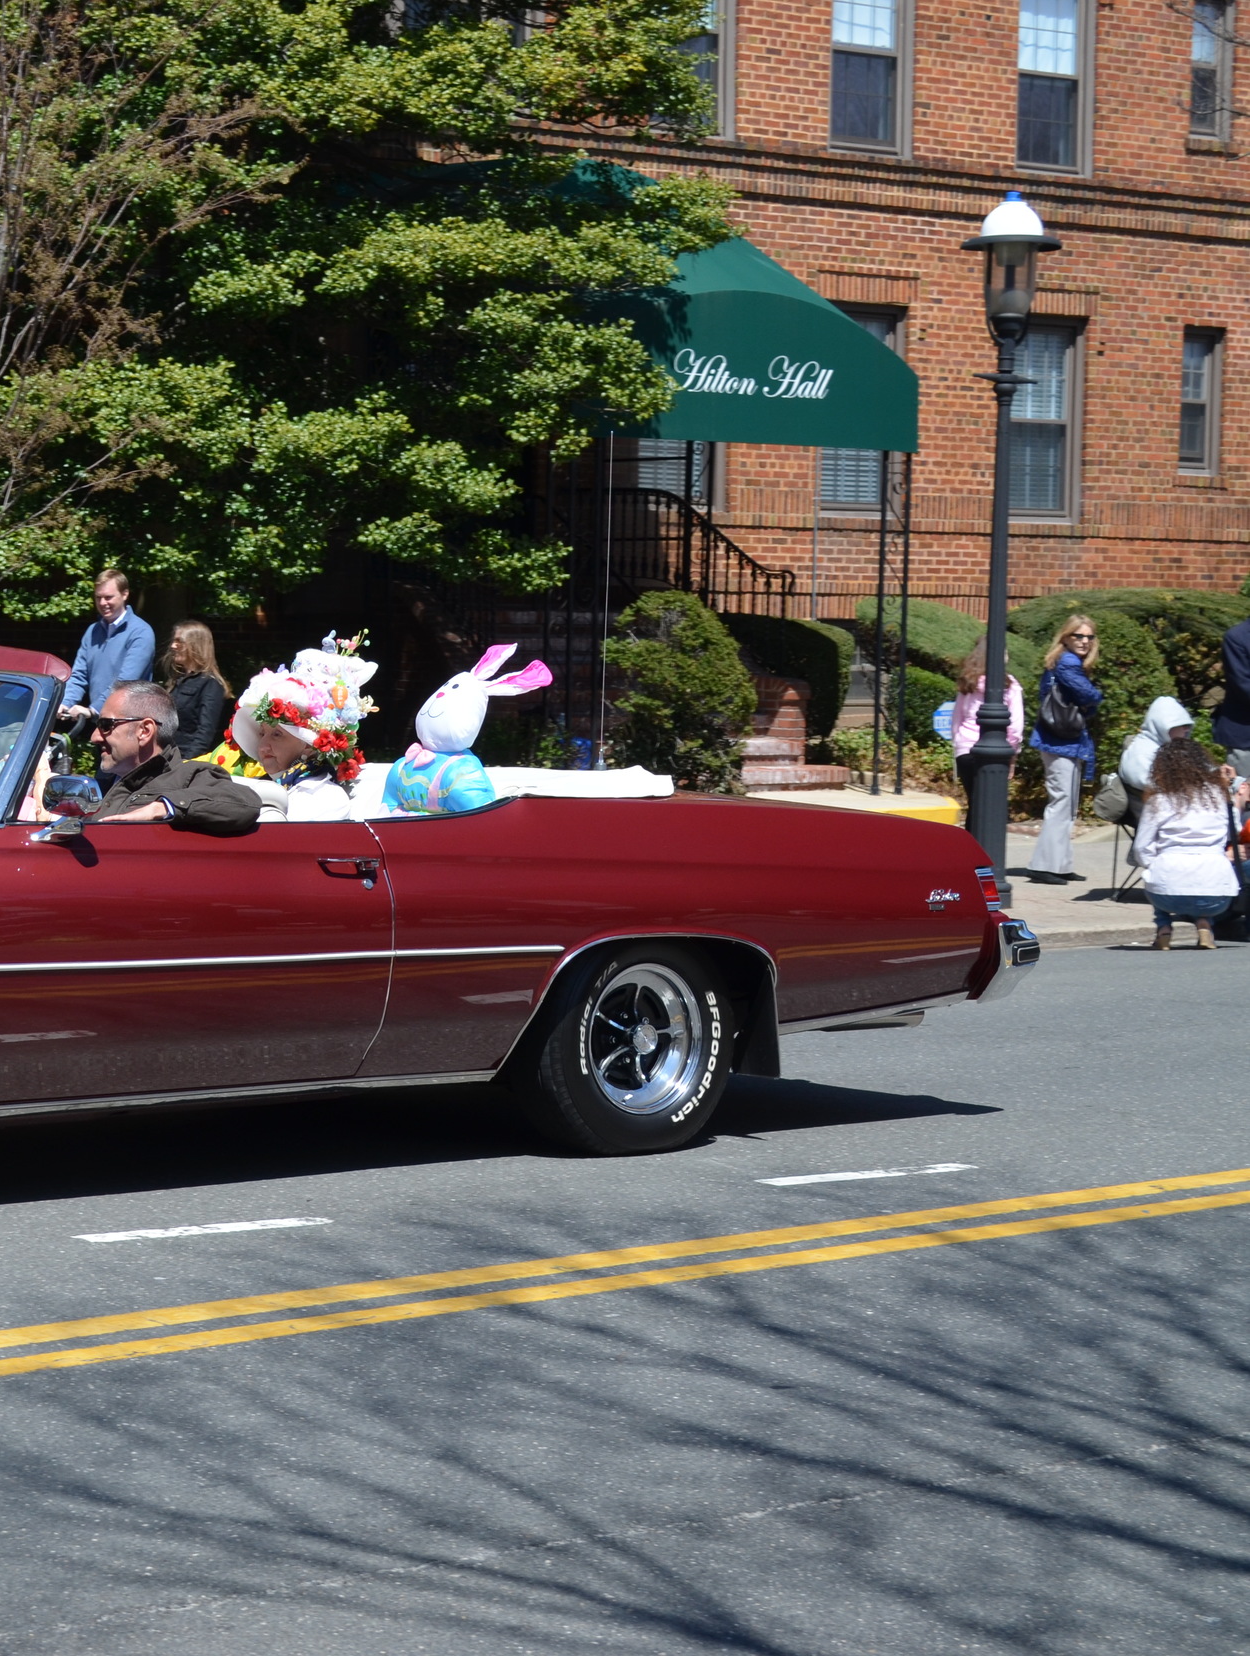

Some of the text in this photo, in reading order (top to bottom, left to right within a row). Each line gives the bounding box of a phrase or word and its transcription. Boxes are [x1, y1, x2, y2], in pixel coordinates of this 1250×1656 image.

[673, 348, 834, 399] Hilton Hall
[594, 961, 619, 989] T/A
[579, 996, 593, 1075] Radial
[671, 990, 722, 1124] BFGoodrich
